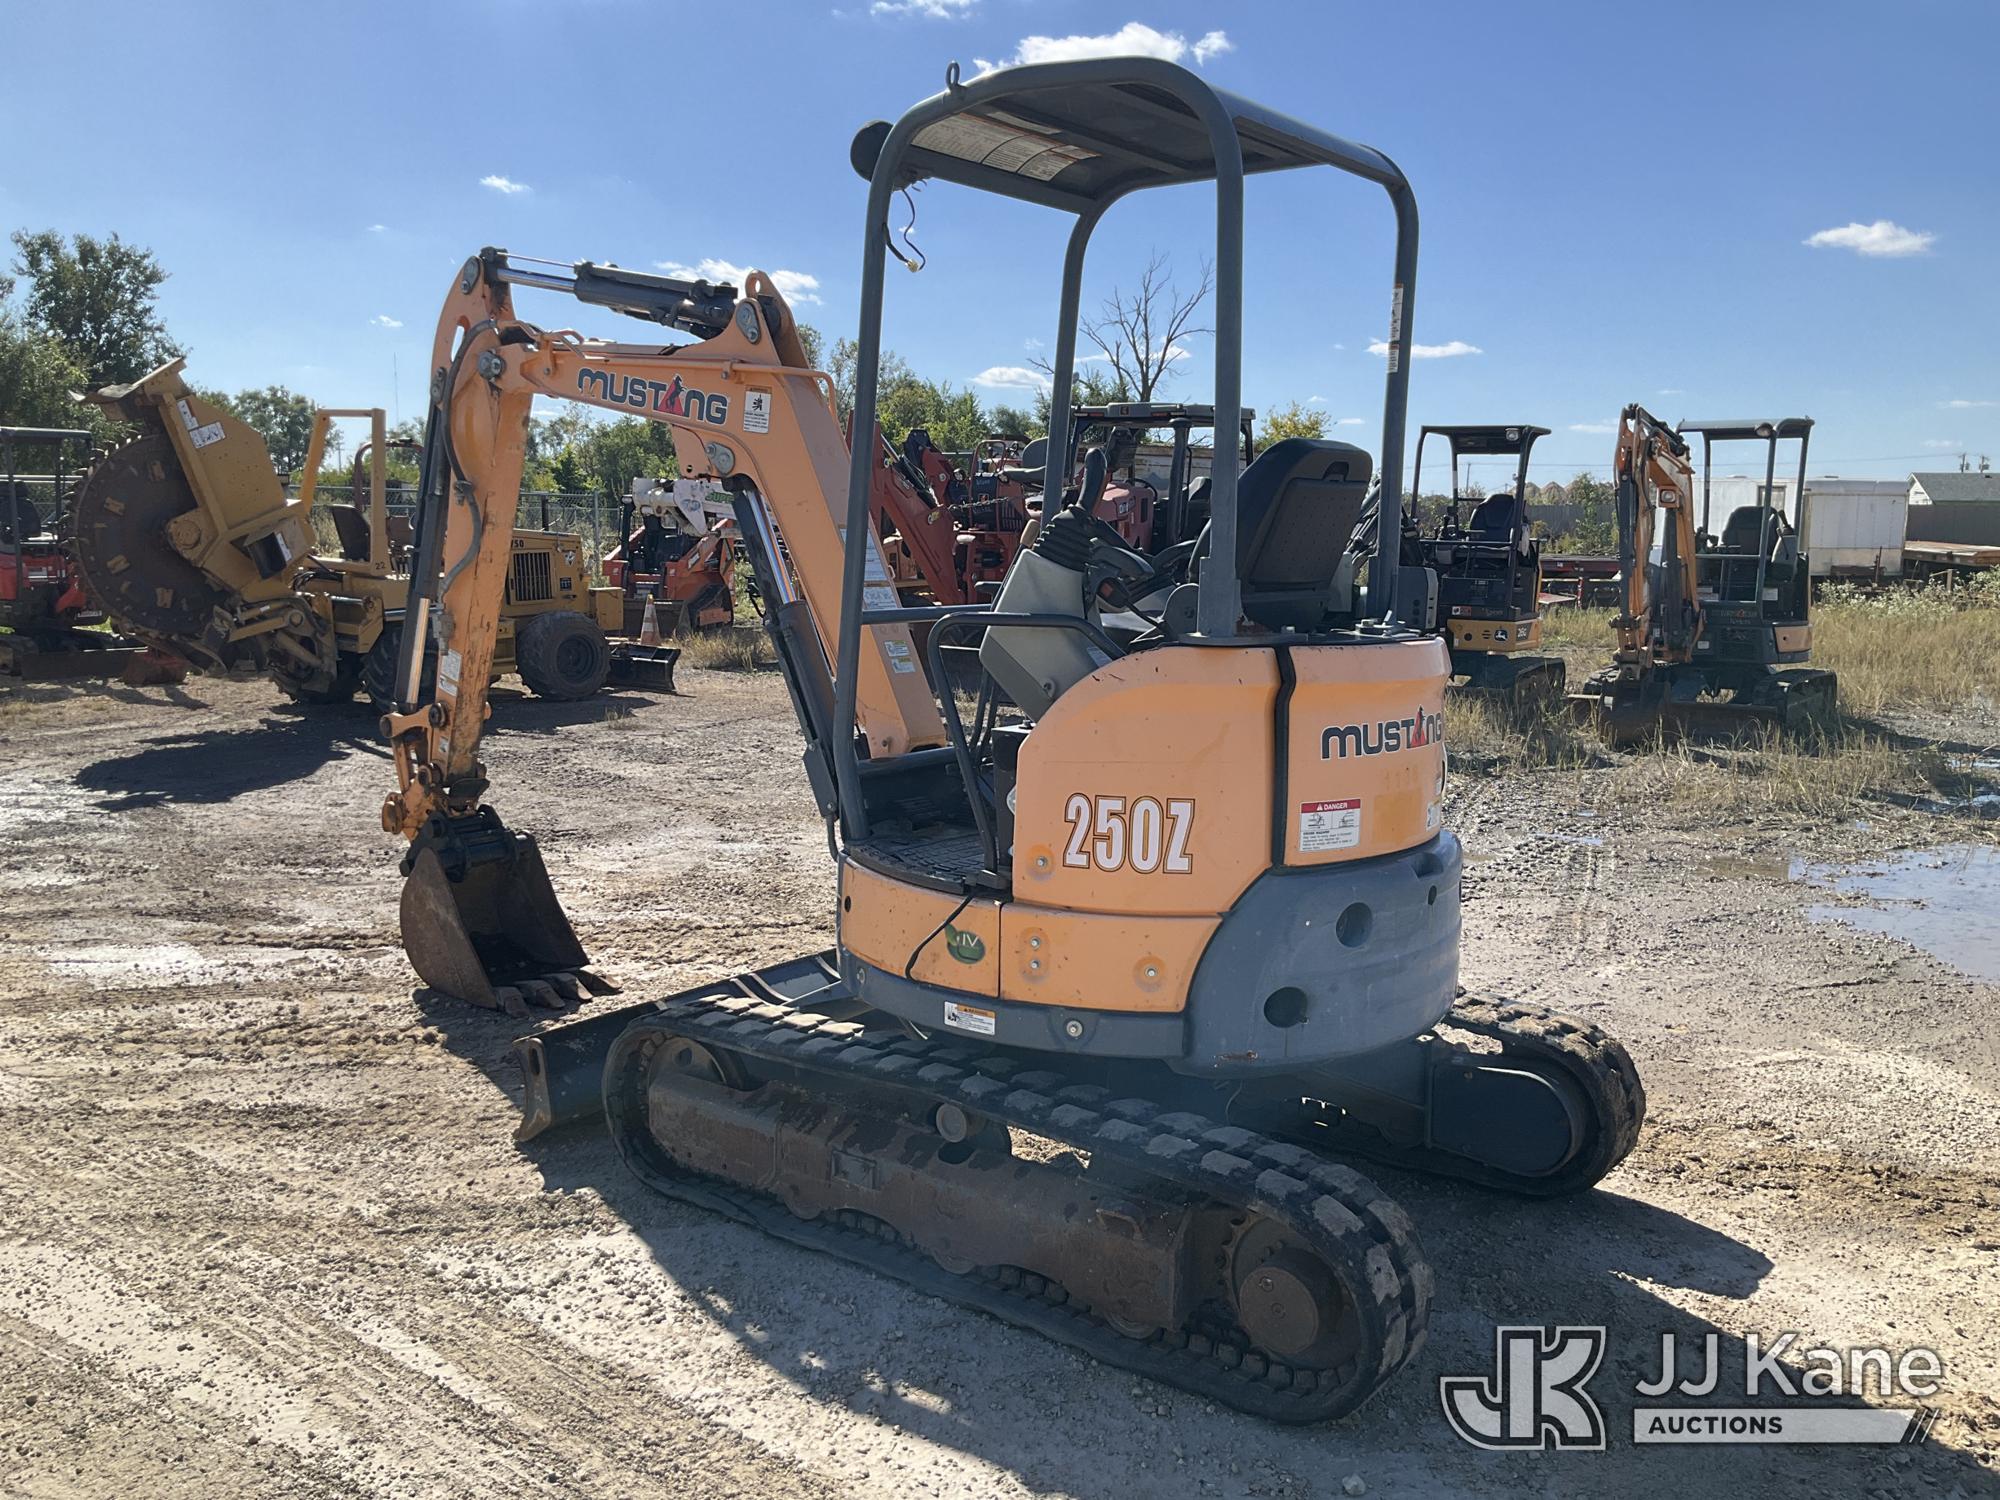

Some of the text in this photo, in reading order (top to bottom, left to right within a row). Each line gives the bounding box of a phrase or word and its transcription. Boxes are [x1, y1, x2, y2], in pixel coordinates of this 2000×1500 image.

[578, 367, 729, 425] MUSTANG
[511, 540, 525, 548] 50
[1320, 704, 1442, 761] MUSTANG
[1062, 793, 1196, 875] 250Z
[1323, 802, 1348, 811] DANGER
